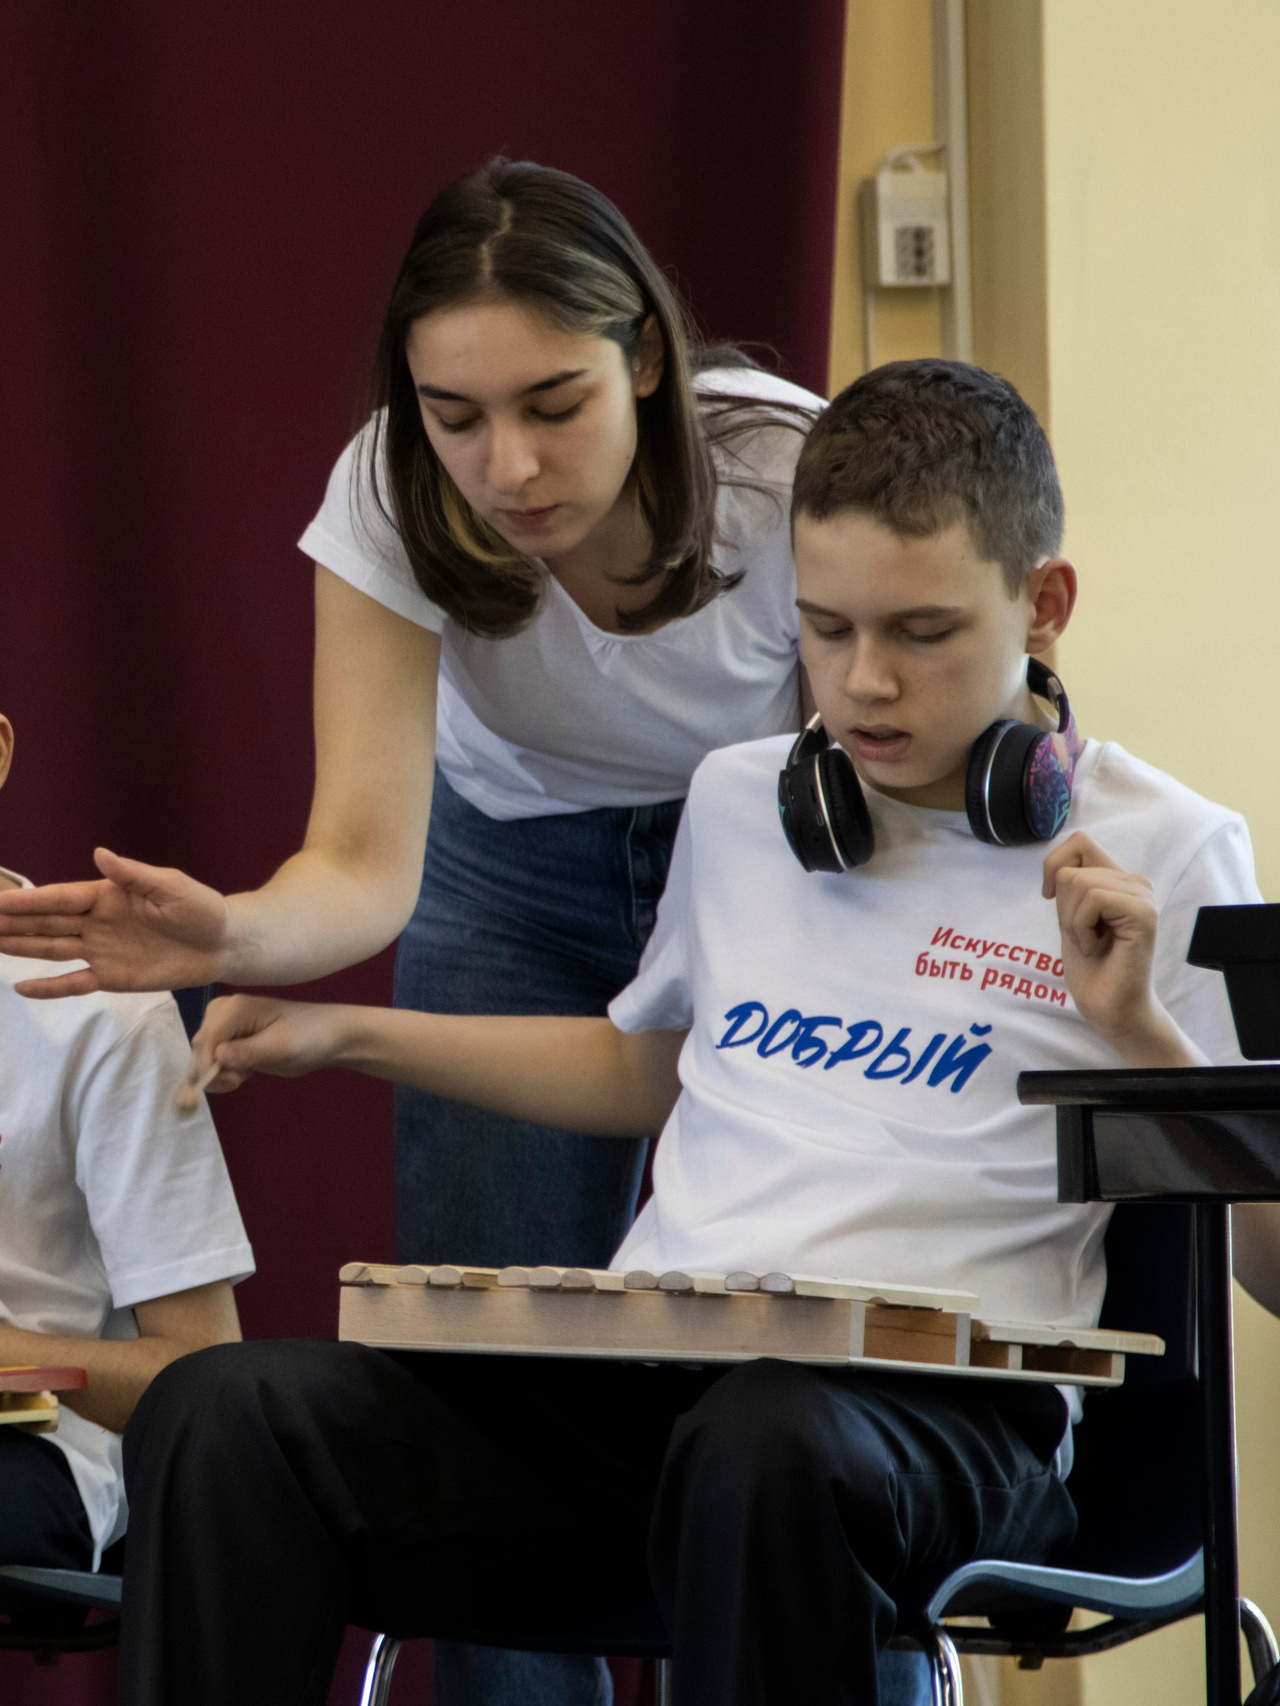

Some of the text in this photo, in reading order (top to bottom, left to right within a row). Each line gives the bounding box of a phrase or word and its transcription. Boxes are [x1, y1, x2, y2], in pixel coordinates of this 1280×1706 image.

[915, 951, 1067, 1007] быть рядом
[930, 926, 1065, 978] Искусство
[716, 1000, 993, 1094] ДОБРЫЙ
